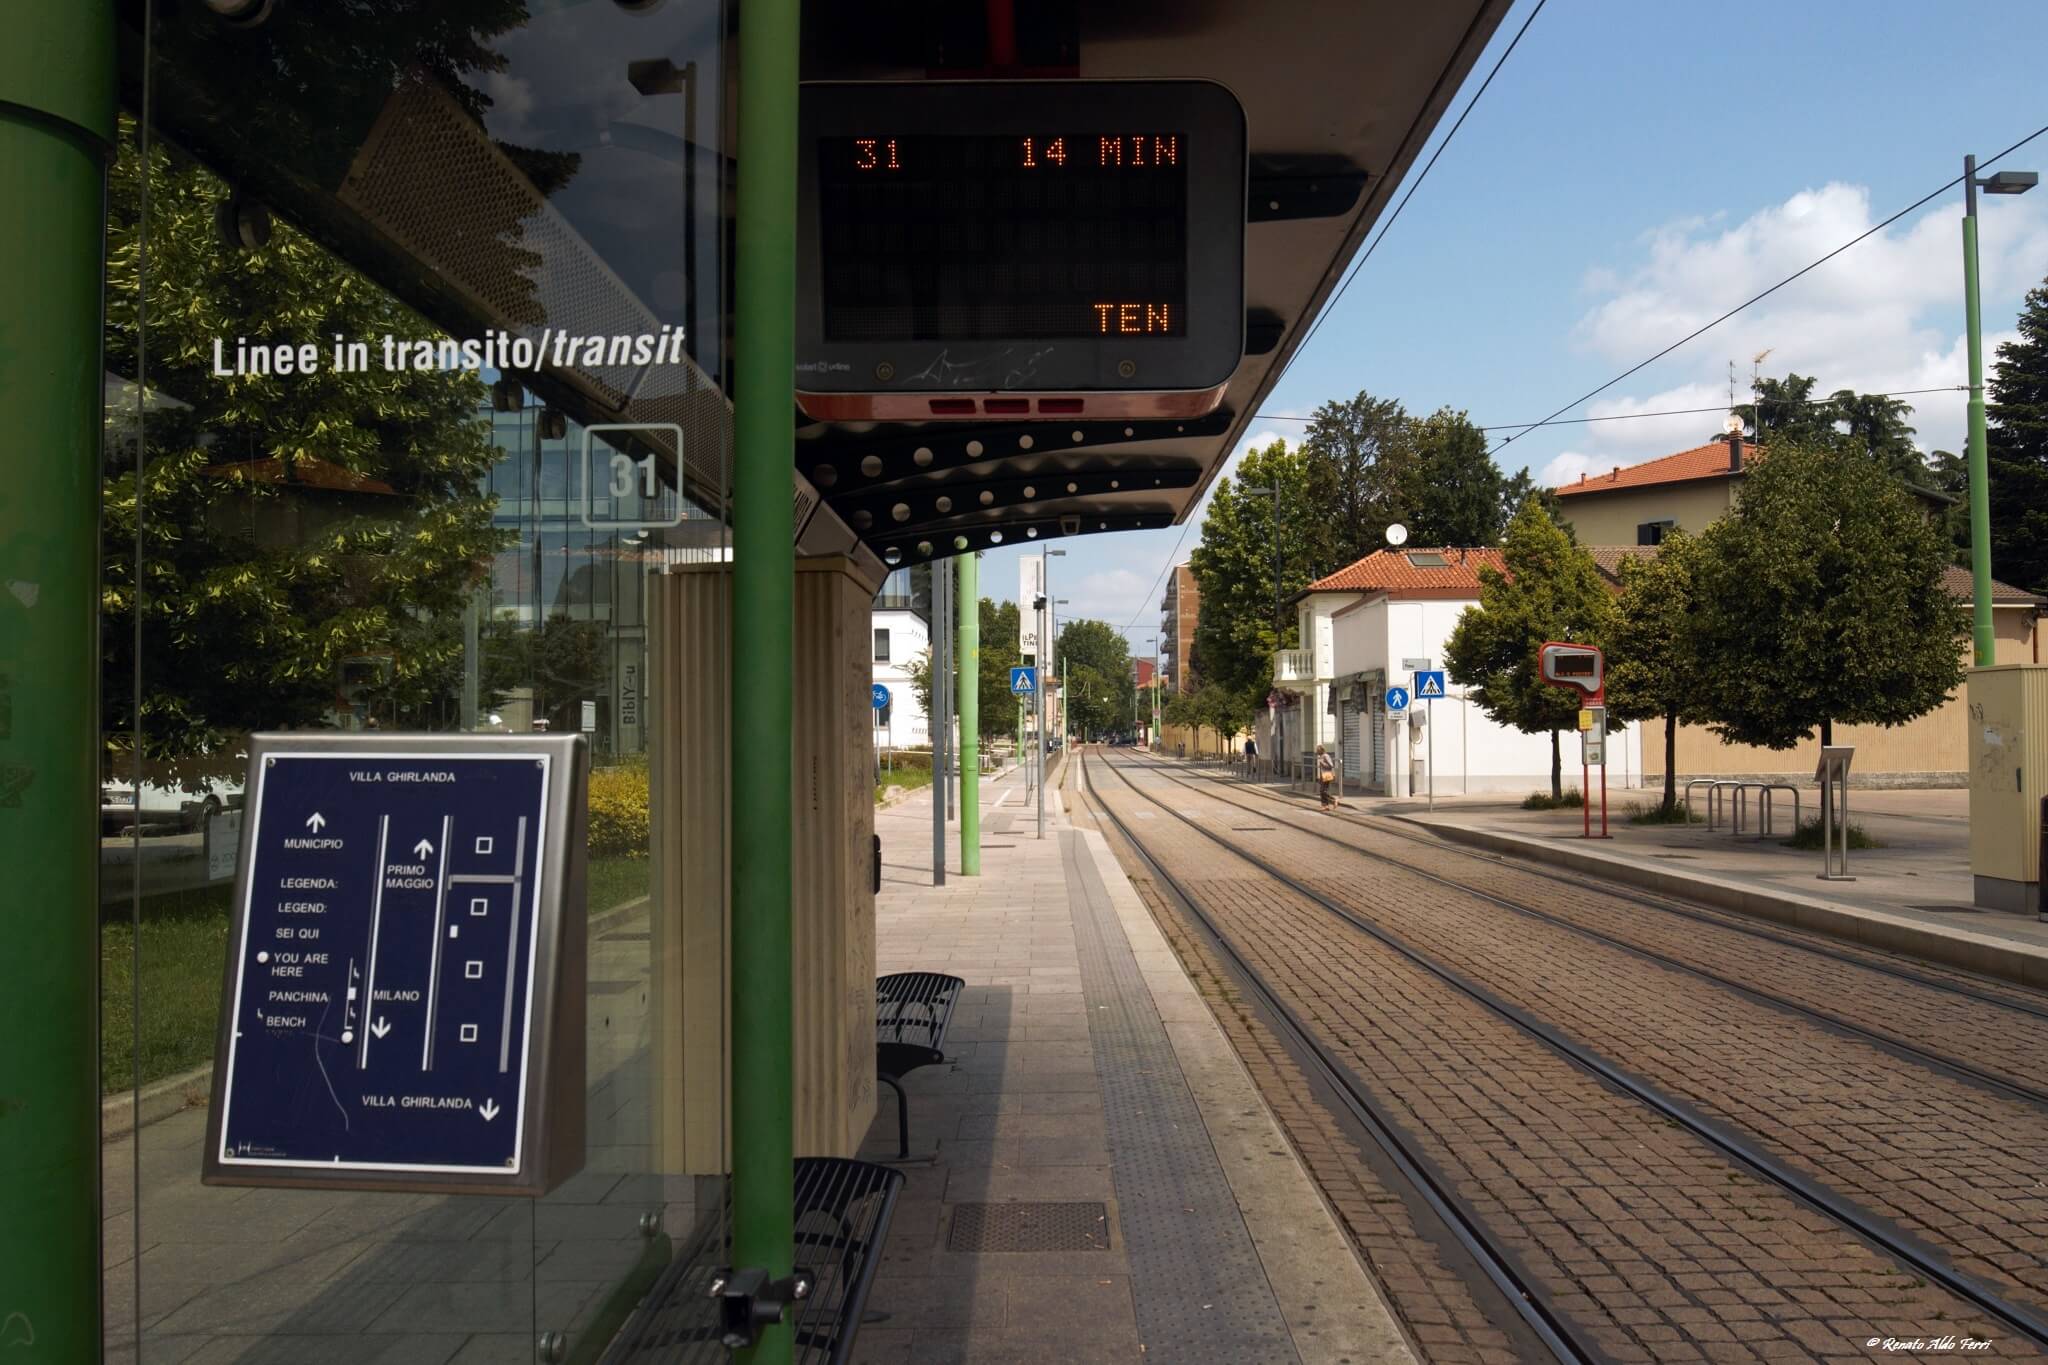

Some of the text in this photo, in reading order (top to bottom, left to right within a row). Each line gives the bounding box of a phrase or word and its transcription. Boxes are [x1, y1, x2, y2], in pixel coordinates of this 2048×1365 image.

[856, 136, 1177, 169] 31 14 MIN
[1094, 303, 1168, 333] TEN
[213, 326, 685, 376] Linee in transito/transit
[609, 453, 655, 497] 31
[349, 771, 456, 783] VILLA GHIRLANDA
[284, 838, 344, 849] MUNICIPIO
[387, 864, 425, 876] PRIMO
[281, 878, 339, 889] LEGENDA:
[385, 878, 434, 889] MAGGIO
[278, 902, 328, 913] LEGEND:
[275, 927, 320, 939] SEI QUI
[274, 952, 328, 964] YOU ARE
[271, 966, 303, 977] HERE
[268, 991, 329, 1003] PANCHINA
[373, 990, 420, 1001] MILANO
[266, 1016, 306, 1028] BENCH
[362, 1095, 472, 1109] VILLA GHIRLANDA
